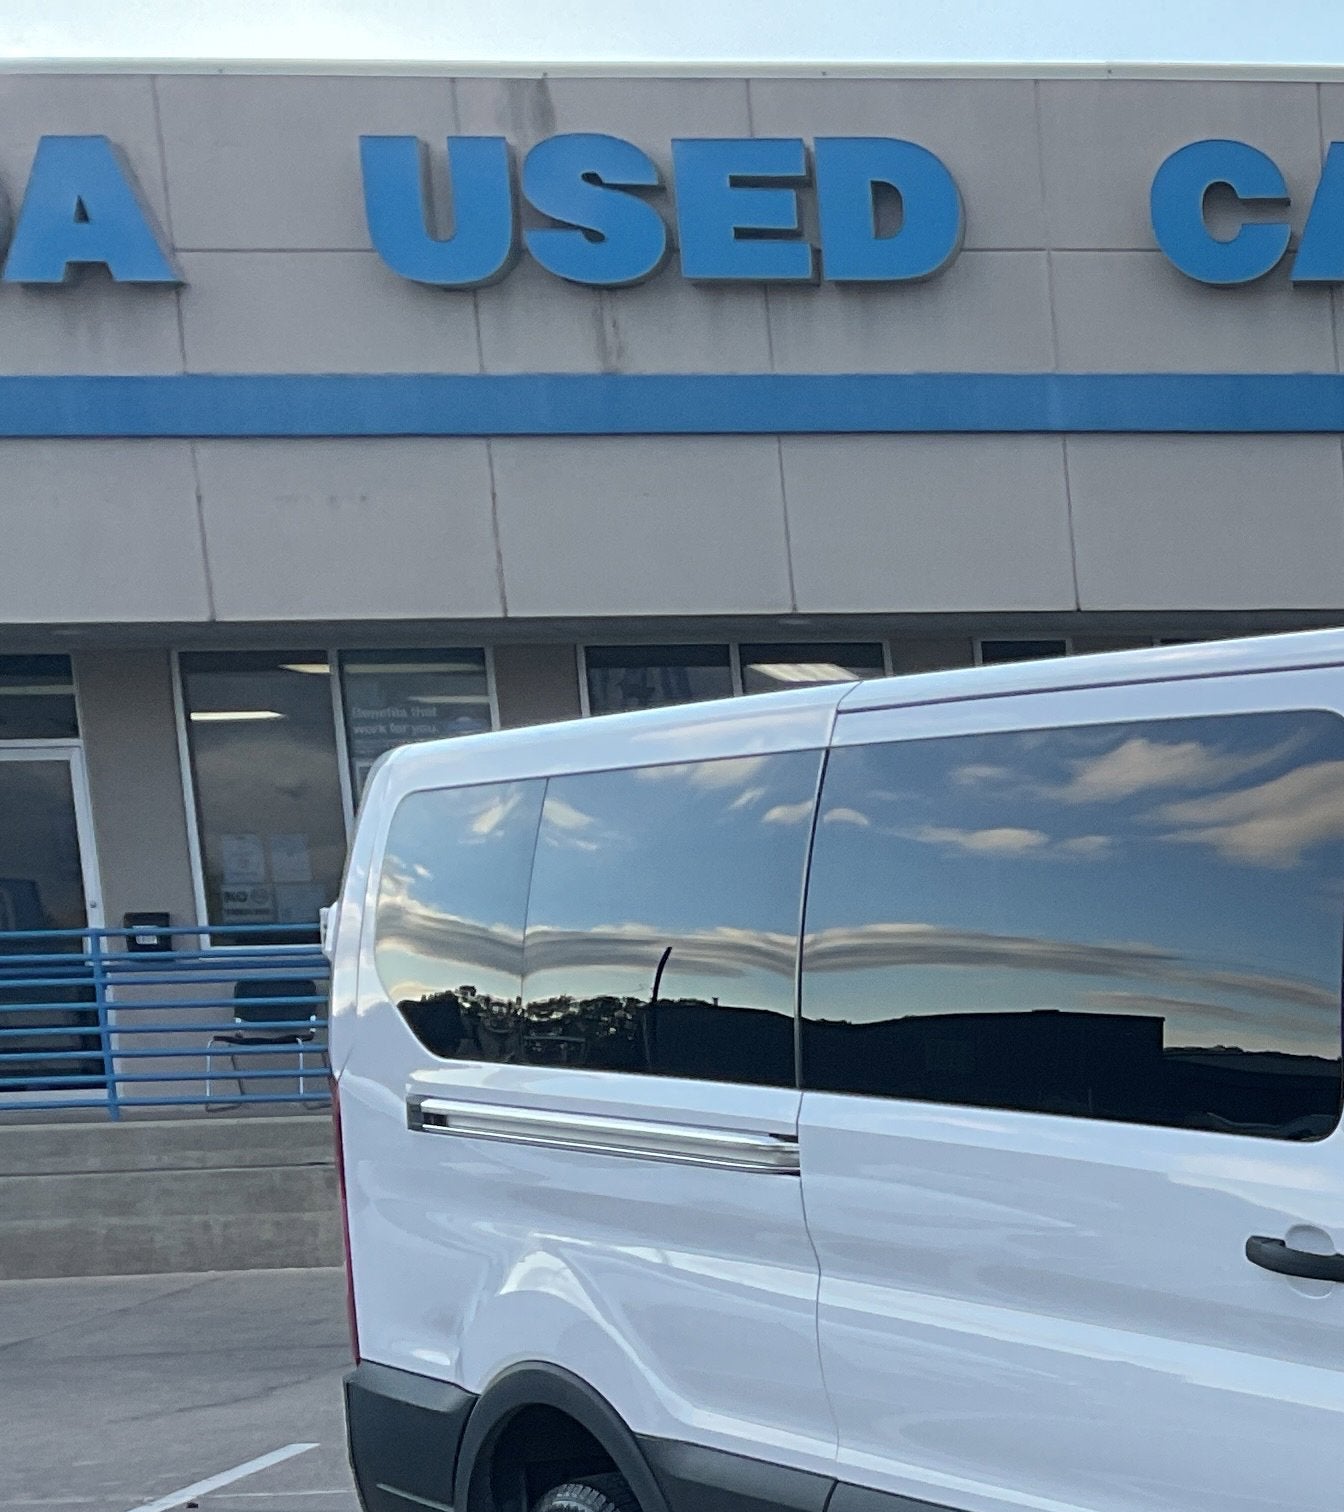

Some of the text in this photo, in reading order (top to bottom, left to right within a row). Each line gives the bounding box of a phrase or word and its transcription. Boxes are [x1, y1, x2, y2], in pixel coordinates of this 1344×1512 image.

[0, 134, 182, 284] A
[359, 132, 965, 288] USED
[410, 706, 437, 718] that
